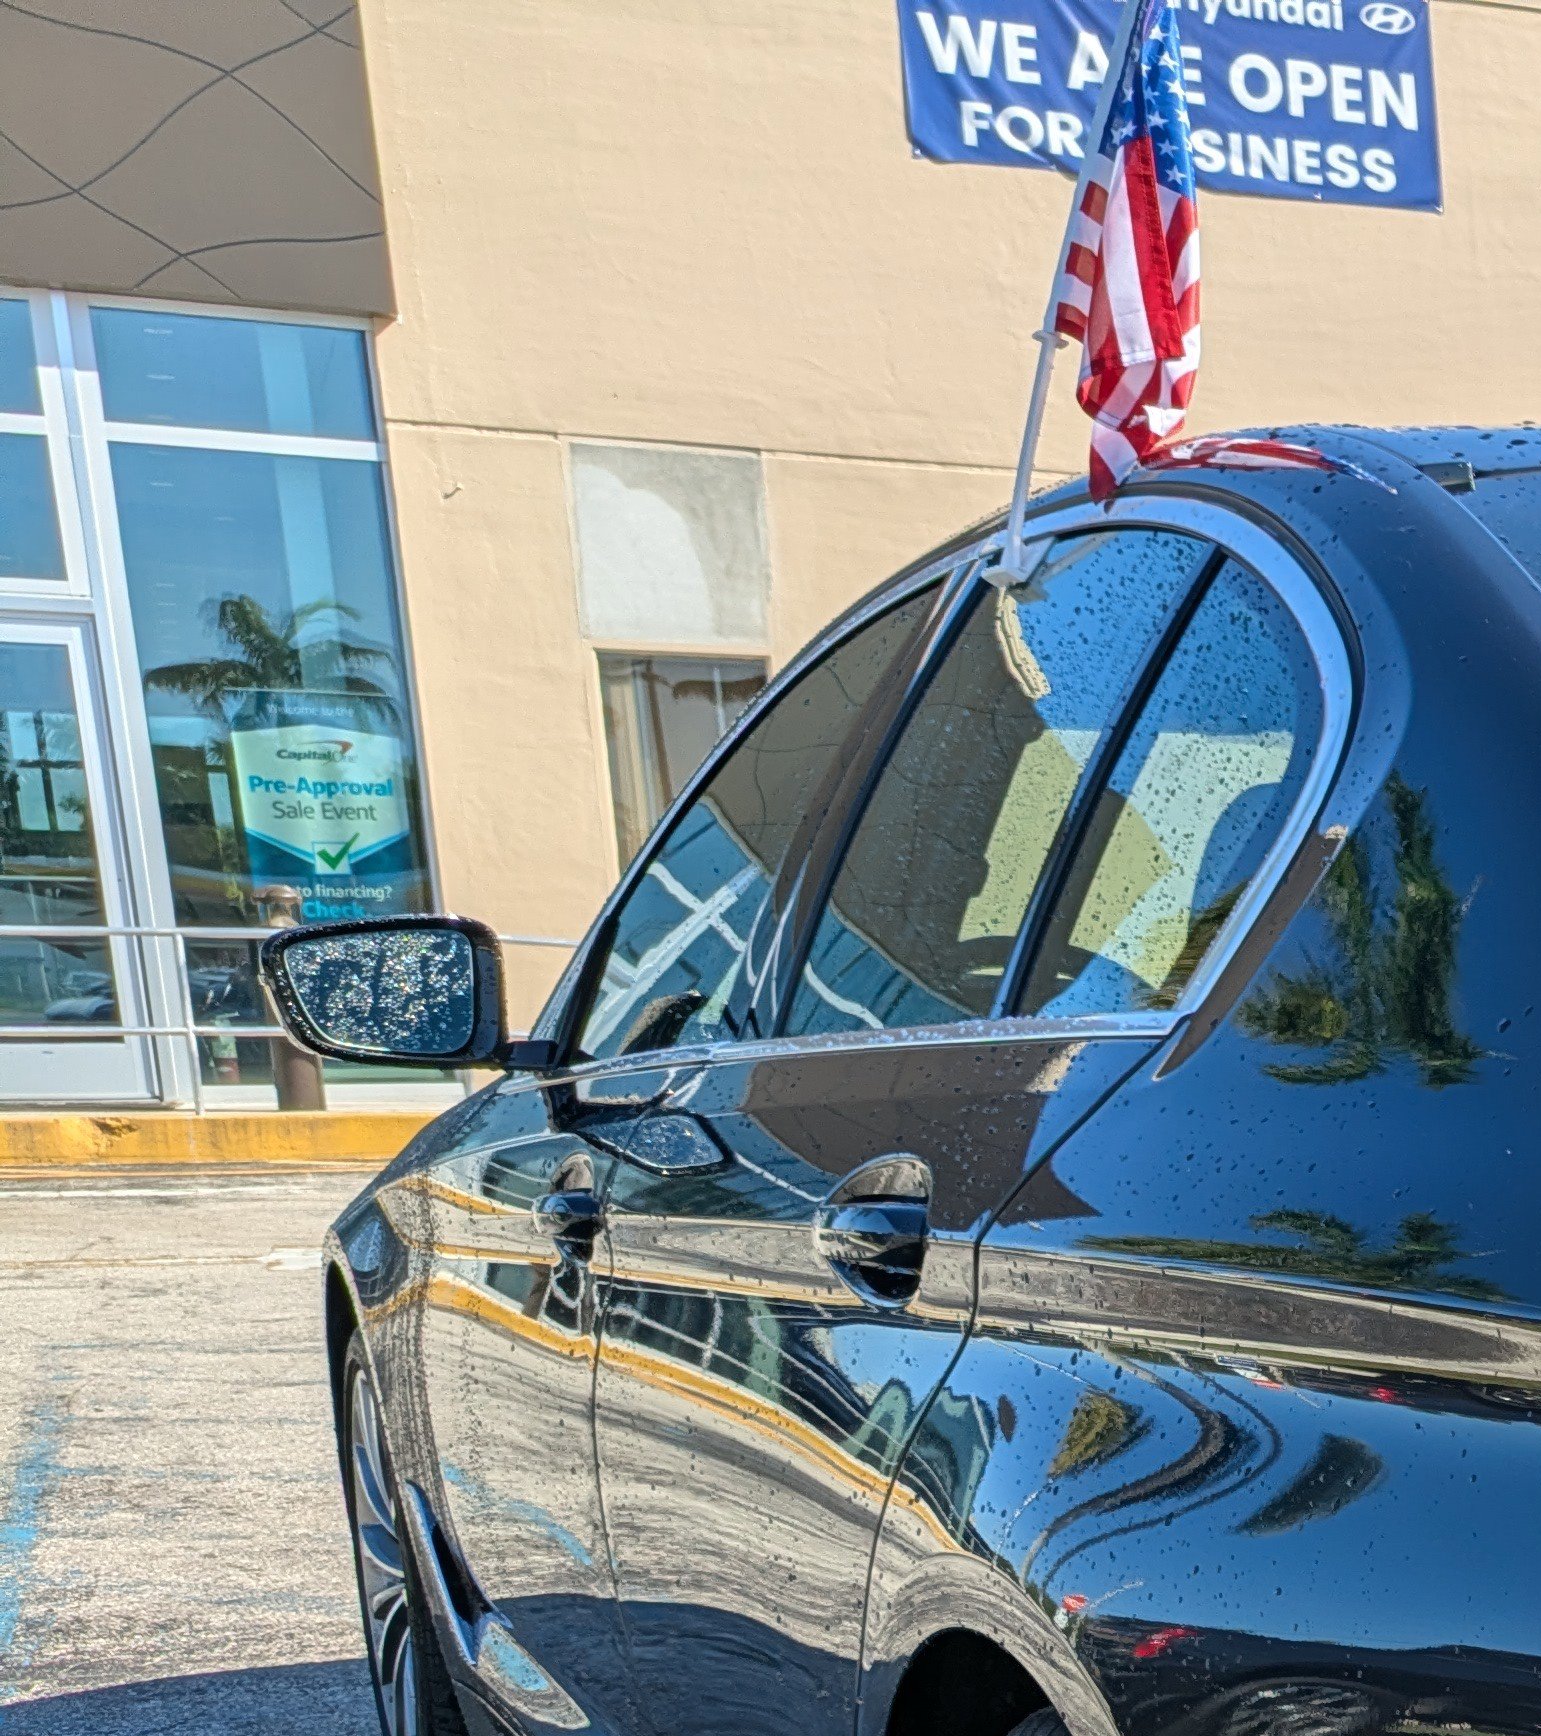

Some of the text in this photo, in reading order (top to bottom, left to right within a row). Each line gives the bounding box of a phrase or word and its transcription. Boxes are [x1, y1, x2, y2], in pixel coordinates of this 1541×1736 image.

[1174, 0, 1343, 31] yundai
[916, 12, 1418, 130] WE AE OPEN
[962, 102, 1397, 192] FOR SINESS
[248, 775, 394, 799] Pre-Approval
[272, 800, 377, 821] Sale Event
[315, 884, 393, 902] financing?
